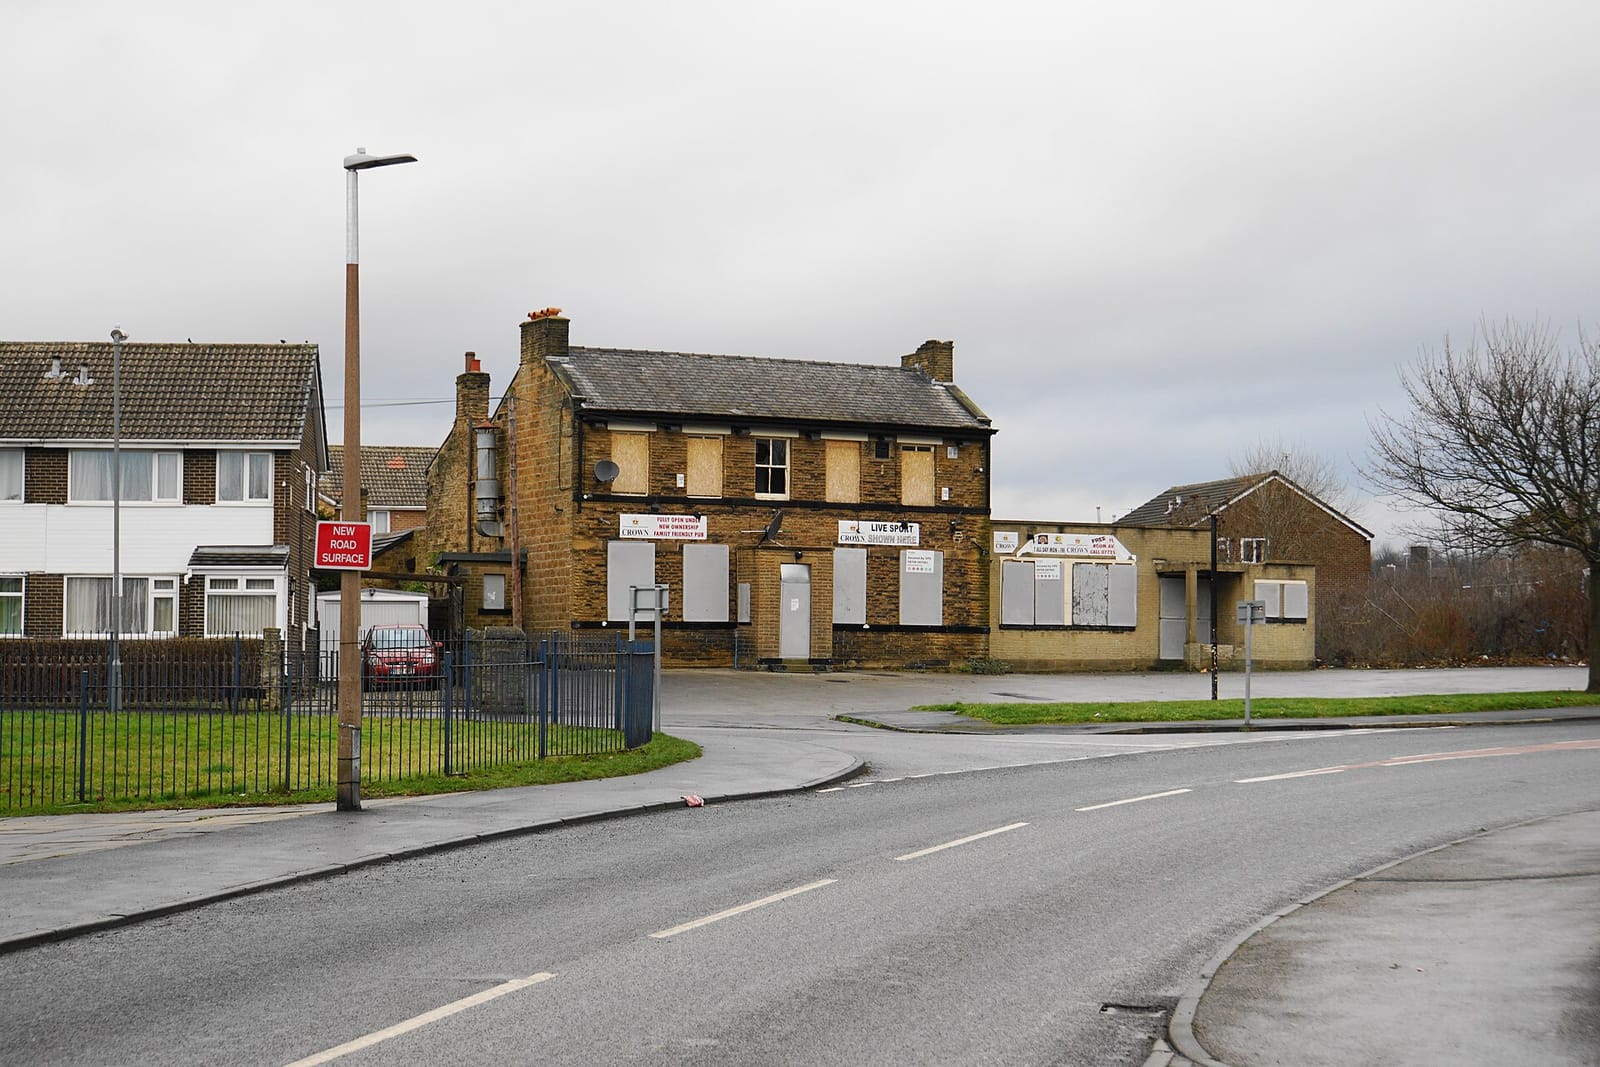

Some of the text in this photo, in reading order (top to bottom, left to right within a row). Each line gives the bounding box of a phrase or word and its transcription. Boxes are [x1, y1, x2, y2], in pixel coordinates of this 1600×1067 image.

[333, 526, 355, 536] NEW
[622, 528, 649, 536] CROWN
[871, 523, 888, 532] LIVE
[868, 534, 917, 545] SHOWN HERE
[330, 540, 357, 550] ROAD
[322, 553, 364, 564] SURFACE
